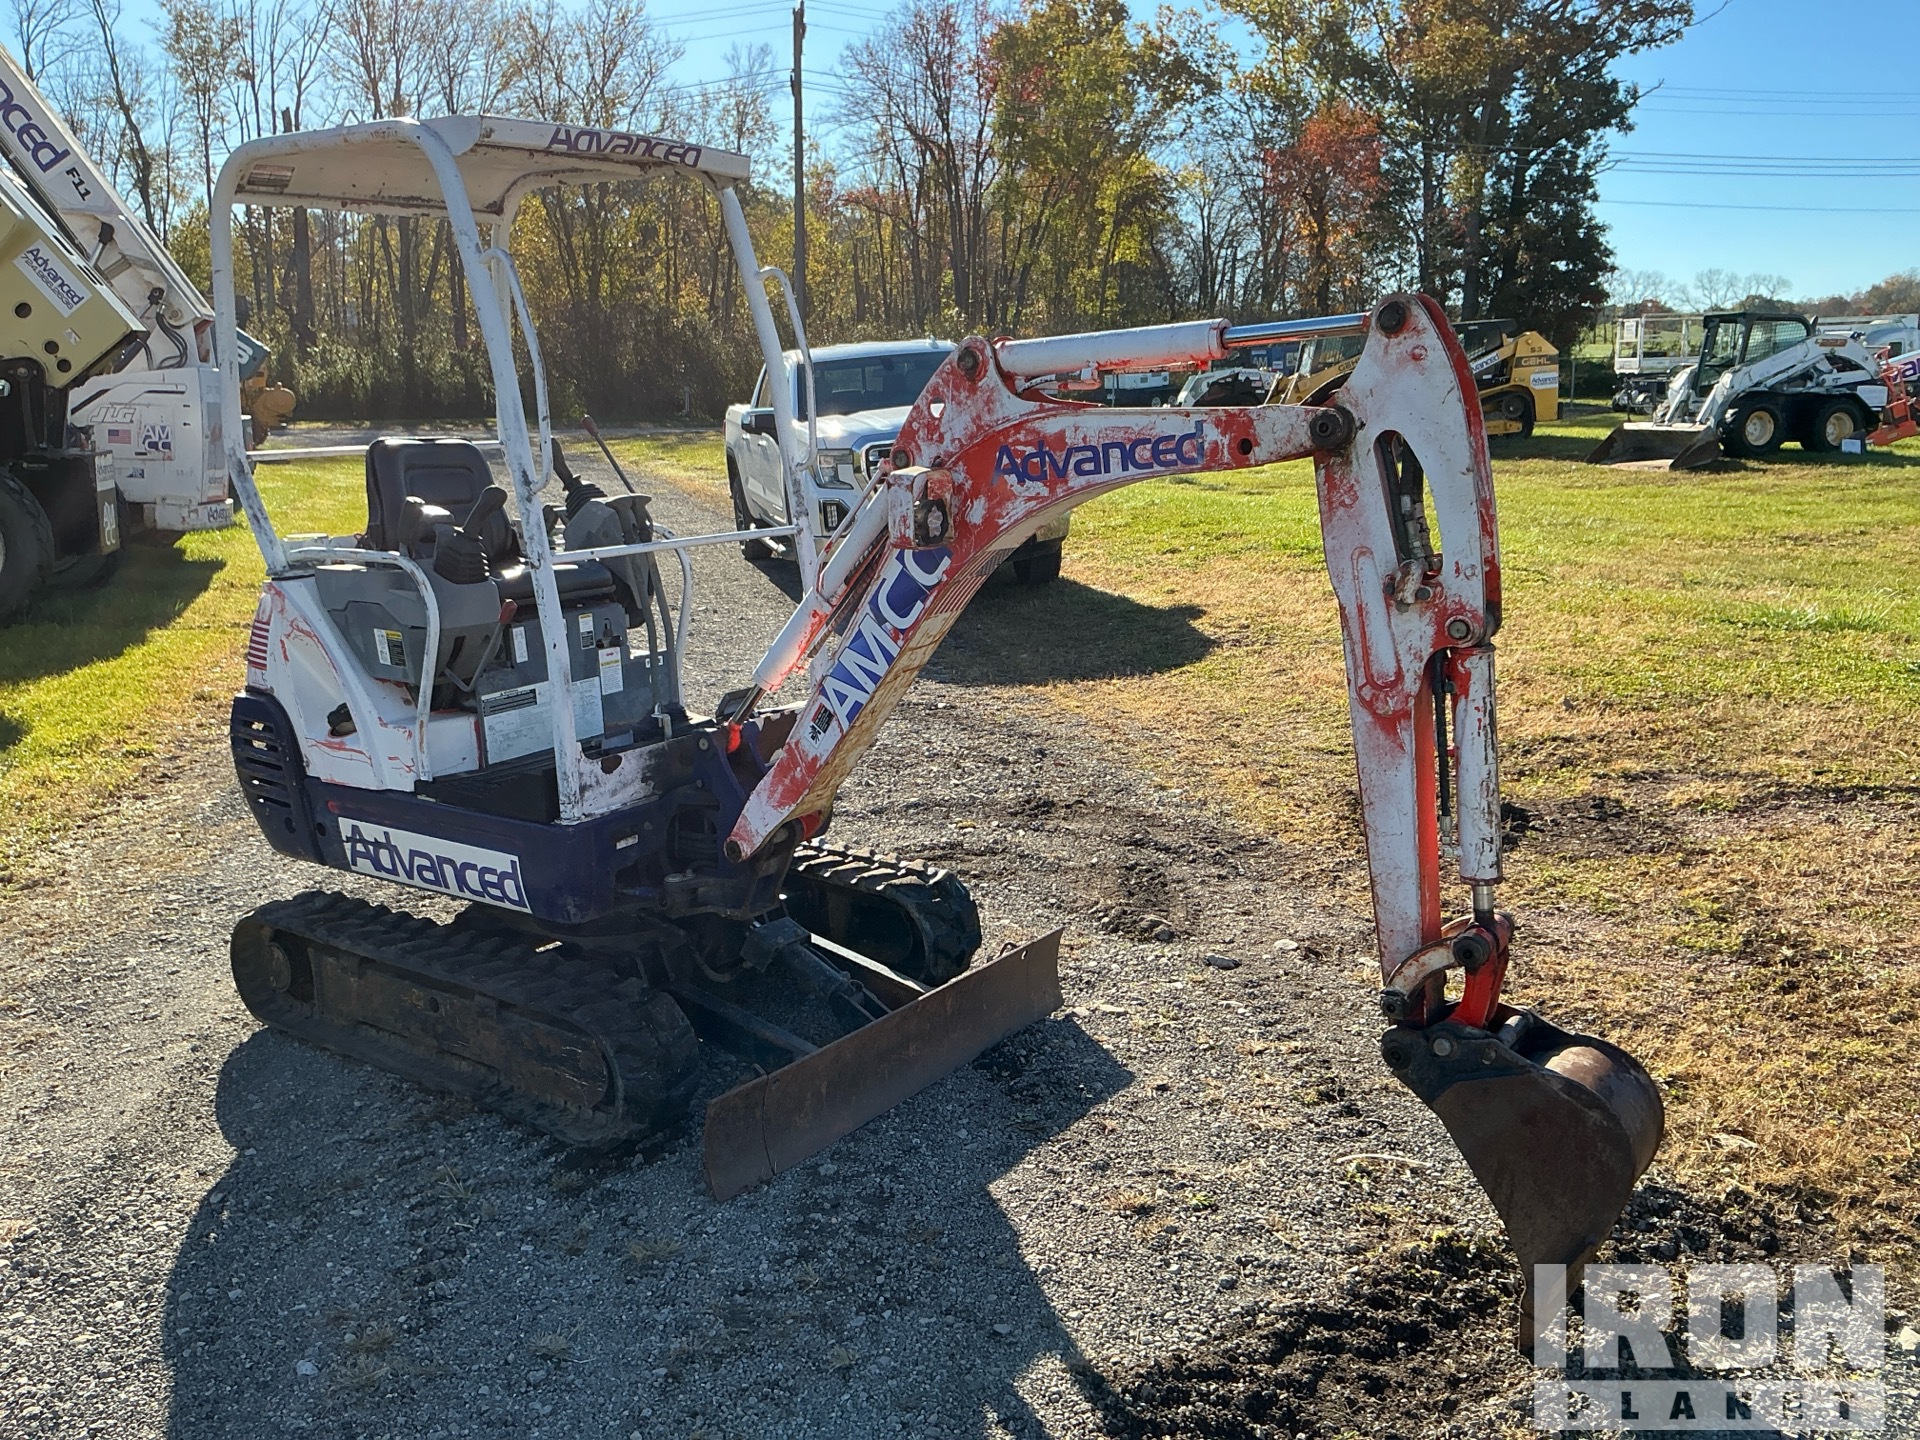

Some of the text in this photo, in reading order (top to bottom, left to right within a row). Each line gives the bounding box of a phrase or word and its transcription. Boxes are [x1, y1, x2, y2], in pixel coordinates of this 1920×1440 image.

[546, 127, 702, 168] Advanced
[66, 167, 92, 202] F11
[26, 248, 85, 306] Advanced
[1521, 356, 1551, 366] GEHL
[90, 407, 136, 424] JLG
[991, 419, 1206, 486] Advanced
[345, 824, 529, 909] Advanced
